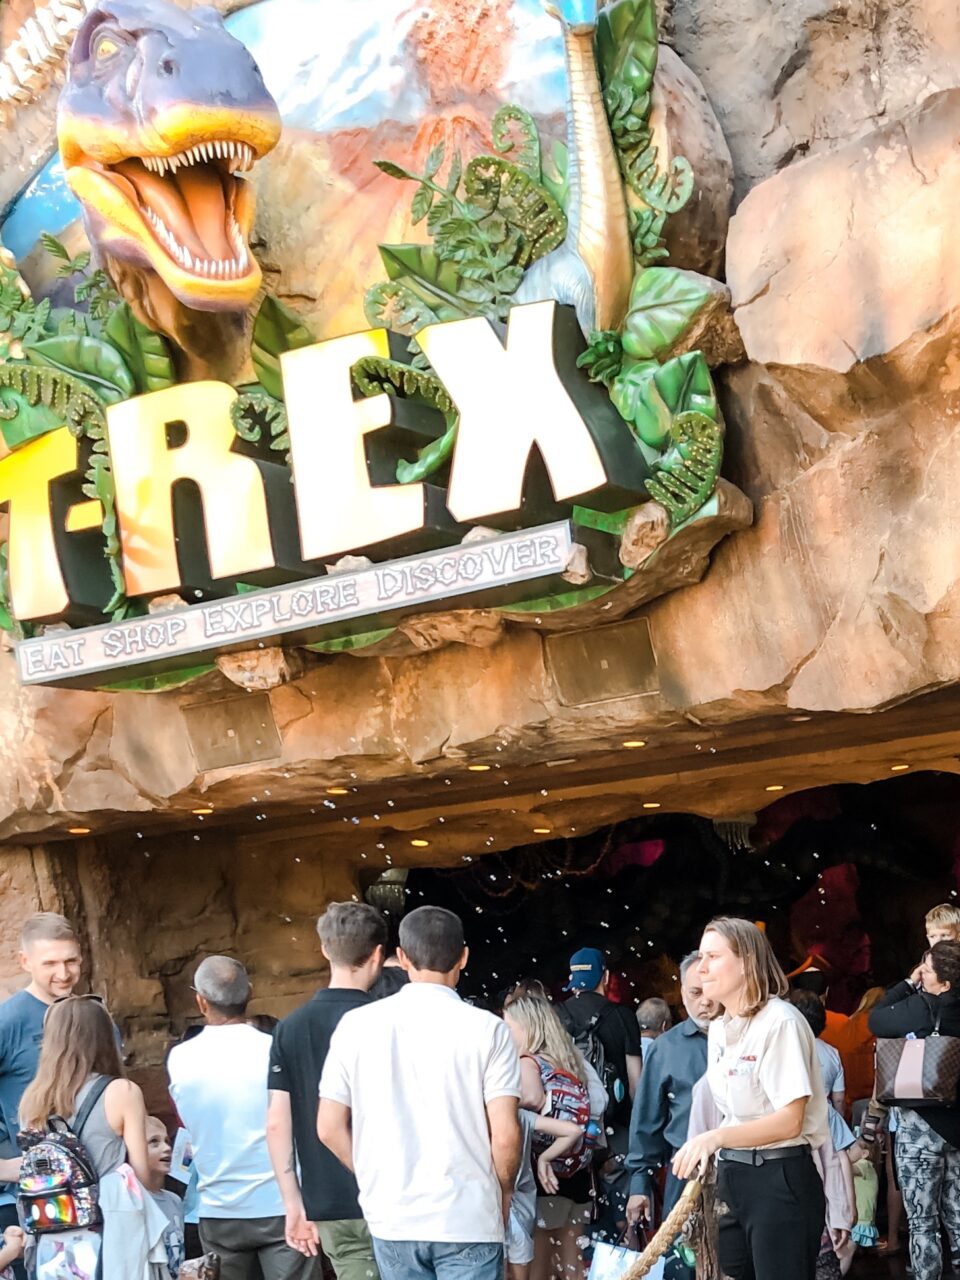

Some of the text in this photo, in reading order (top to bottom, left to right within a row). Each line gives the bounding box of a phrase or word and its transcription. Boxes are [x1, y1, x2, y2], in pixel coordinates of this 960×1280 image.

[0, 300, 608, 621] T-REX
[24, 535, 560, 676] EAT SHOP EXPLORE DISCOVER
